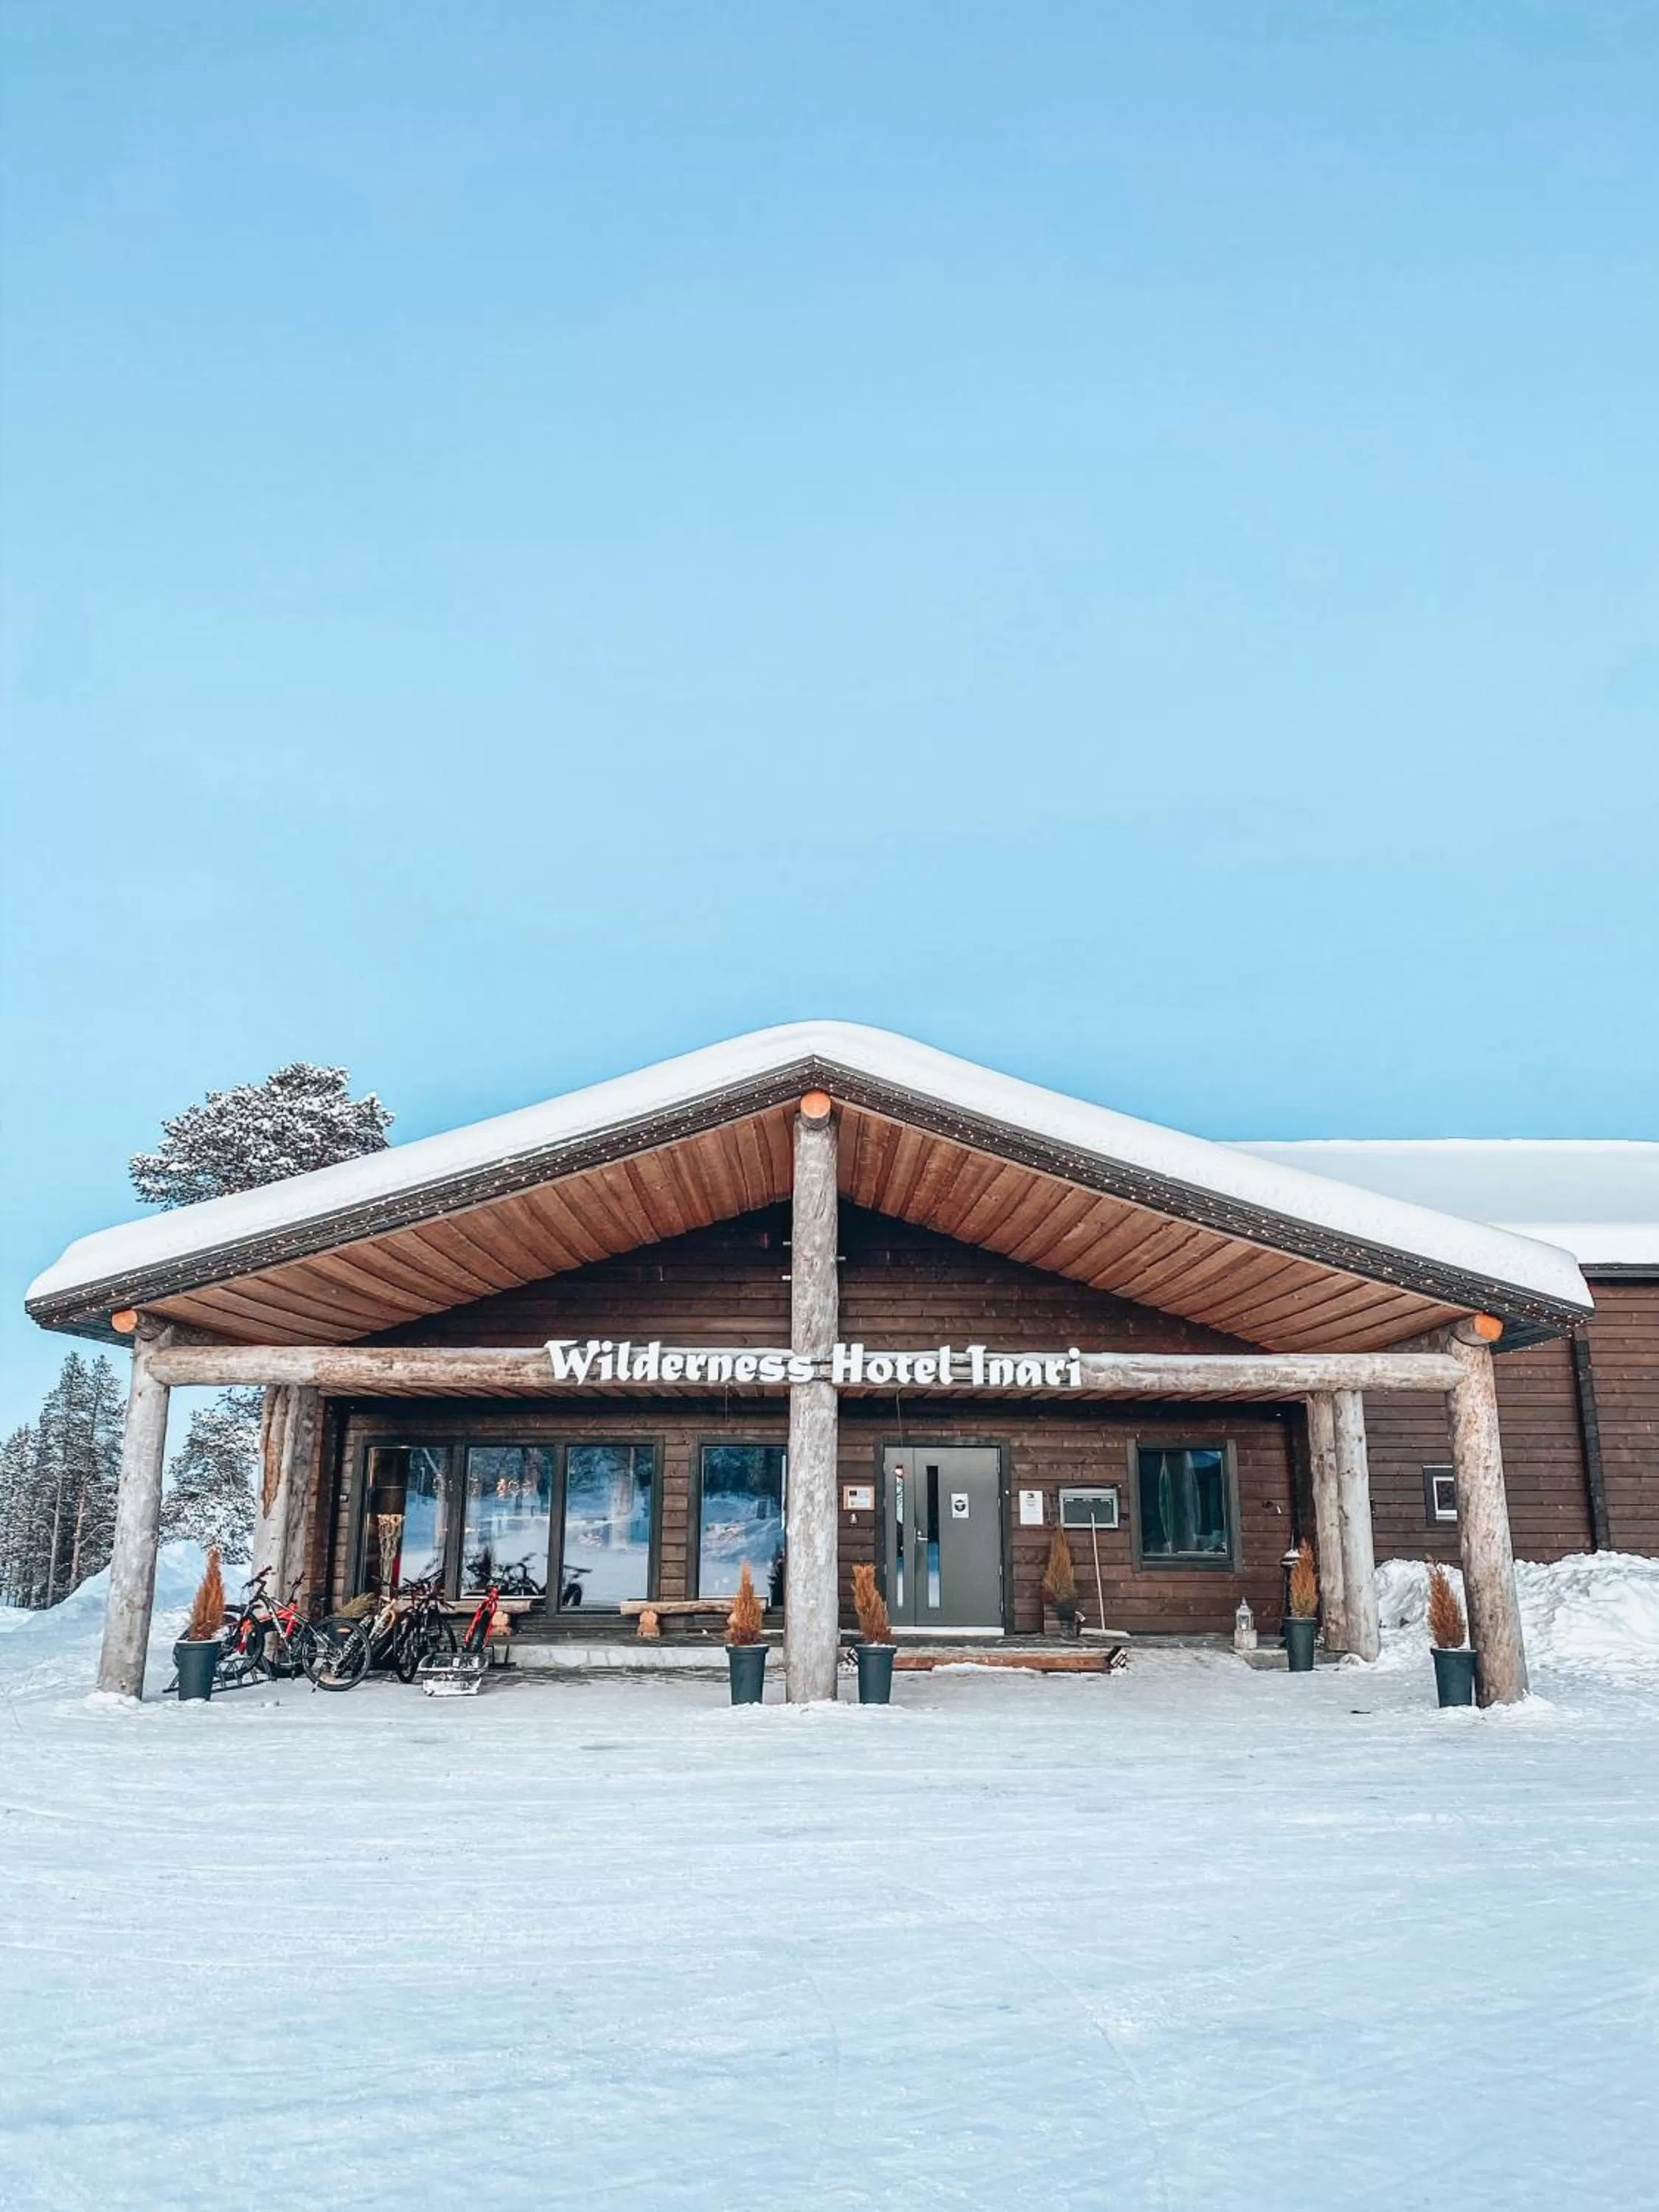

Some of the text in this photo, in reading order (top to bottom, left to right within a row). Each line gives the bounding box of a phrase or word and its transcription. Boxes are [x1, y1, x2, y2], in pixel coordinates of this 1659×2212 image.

[543, 1340, 1082, 1387] Wilderness Hotel Inari
